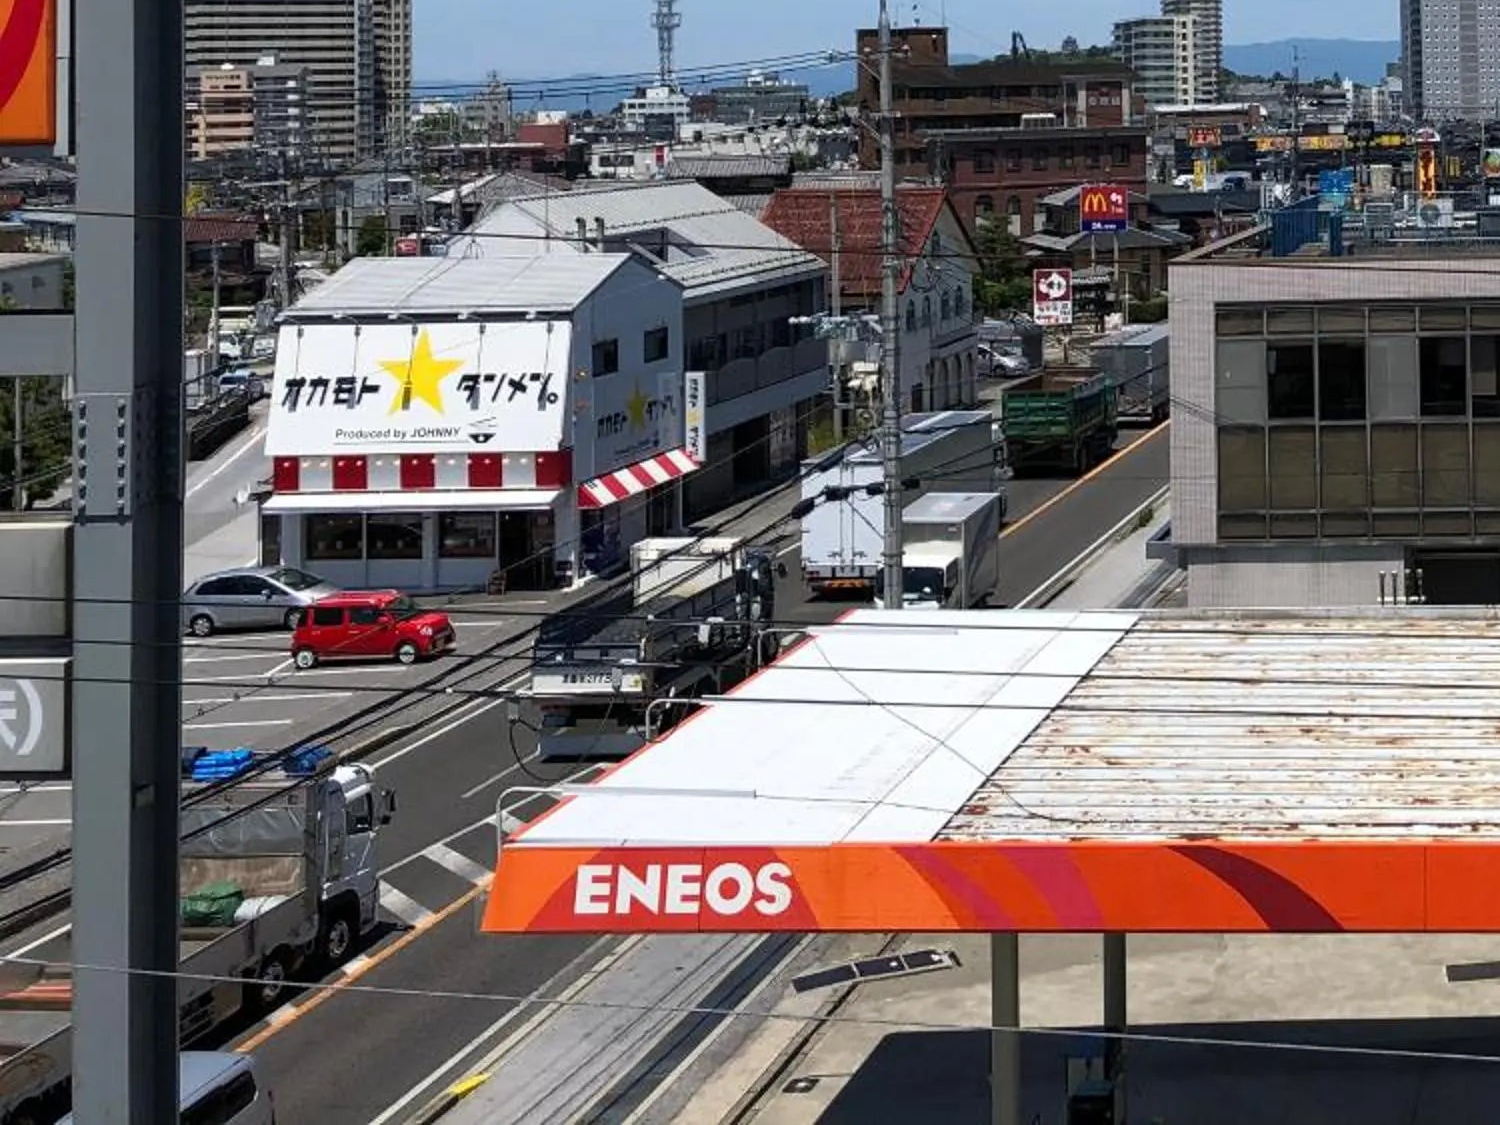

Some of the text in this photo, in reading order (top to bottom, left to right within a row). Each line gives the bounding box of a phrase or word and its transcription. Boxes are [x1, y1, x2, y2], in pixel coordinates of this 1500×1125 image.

[281, 375, 381, 408] オカモト
[335, 426, 461, 441] Produced by JOHNNY
[574, 862, 792, 916] ENEOS
